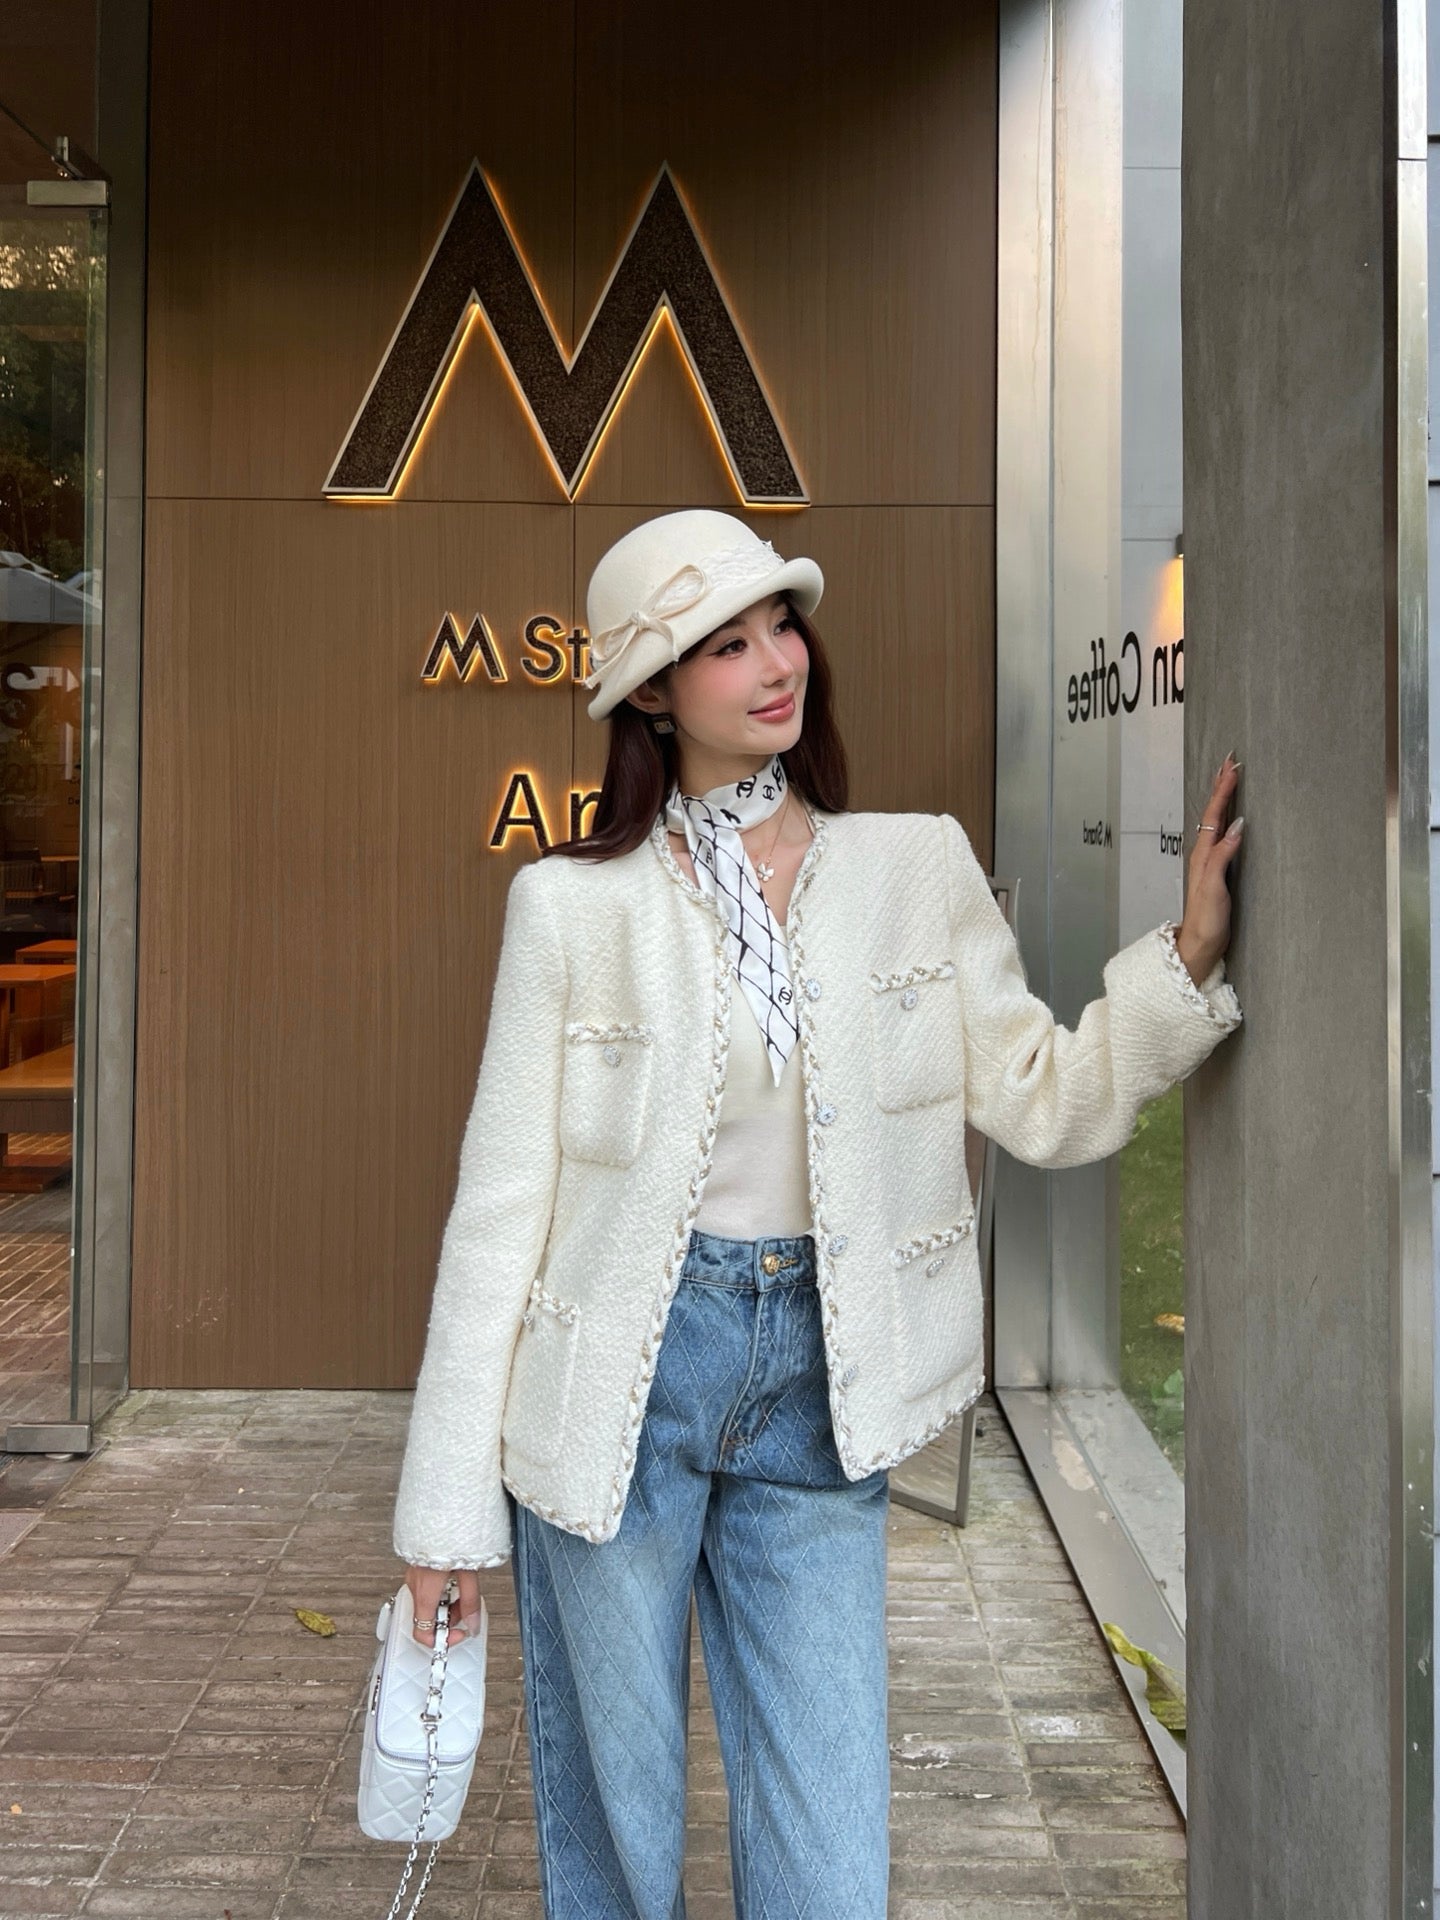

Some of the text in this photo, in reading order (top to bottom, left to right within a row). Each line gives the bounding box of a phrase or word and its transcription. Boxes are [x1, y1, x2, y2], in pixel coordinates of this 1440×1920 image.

[321, 157, 810, 506] M
[420, 611, 594, 682] M St
